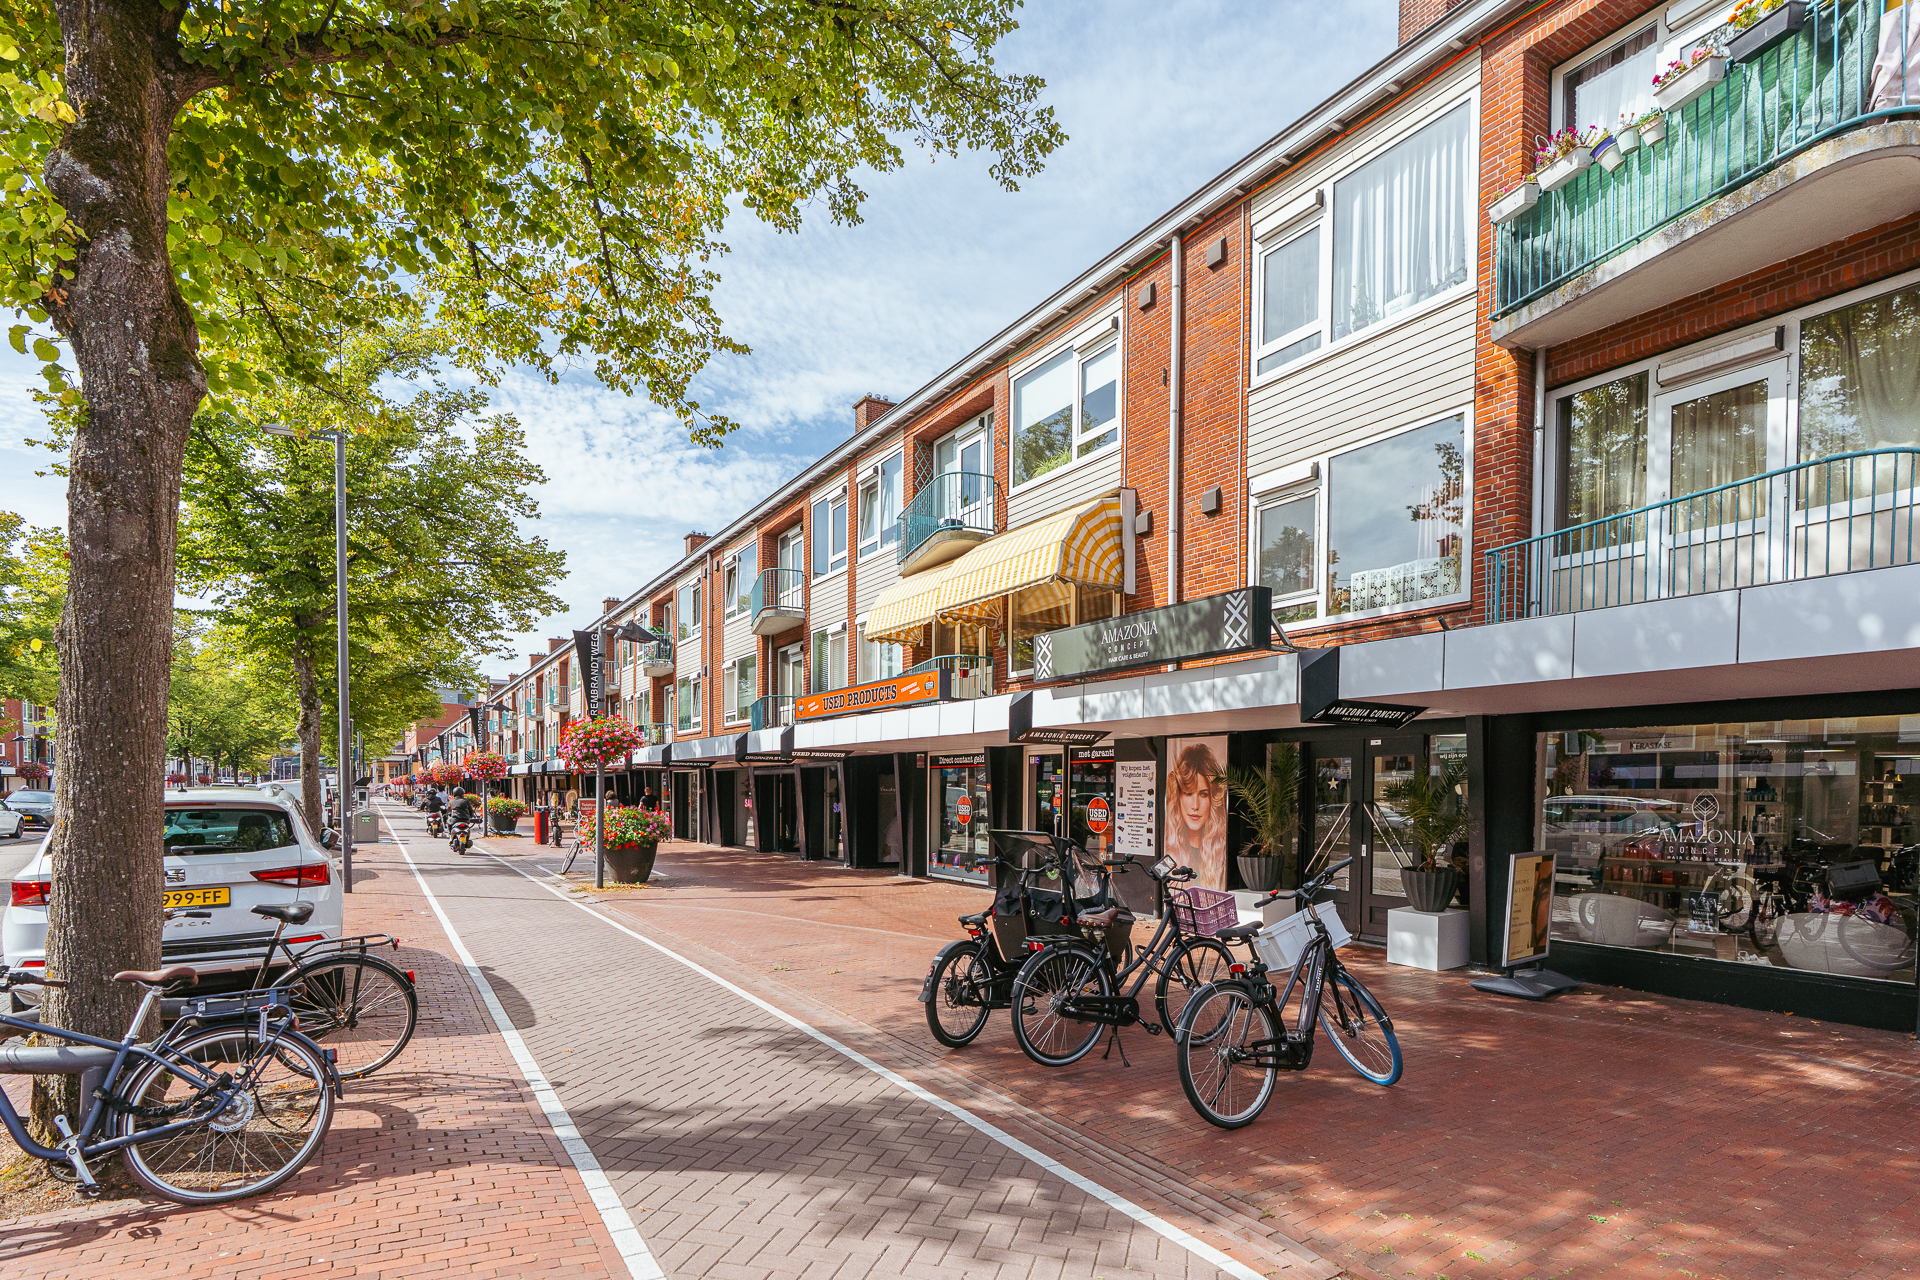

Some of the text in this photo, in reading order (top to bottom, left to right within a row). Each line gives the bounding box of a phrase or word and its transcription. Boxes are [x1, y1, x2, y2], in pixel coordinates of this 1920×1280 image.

[1101, 620, 1158, 645] AMAZONIA
[1108, 639, 1150, 654] CONCEPT
[1133, 651, 1149, 659] BEAUTY
[590, 633, 599, 716] REMBRANDTWEG
[822, 694, 845, 711] USED
[846, 683, 897, 707] PRODUCTS
[1327, 706, 1406, 719] AMAZONIA CONCEPT
[1029, 731, 1064, 739] AMAZONIA
[1078, 749, 1091, 758] met
[1448, 752, 1458, 760] zijn
[939, 756, 954, 765] Direct
[973, 754, 985, 765] geld
[1089, 809, 1108, 818] USED
[1657, 827, 1756, 846] AMAZONIA
[1668, 846, 1741, 856] CONCEPT
